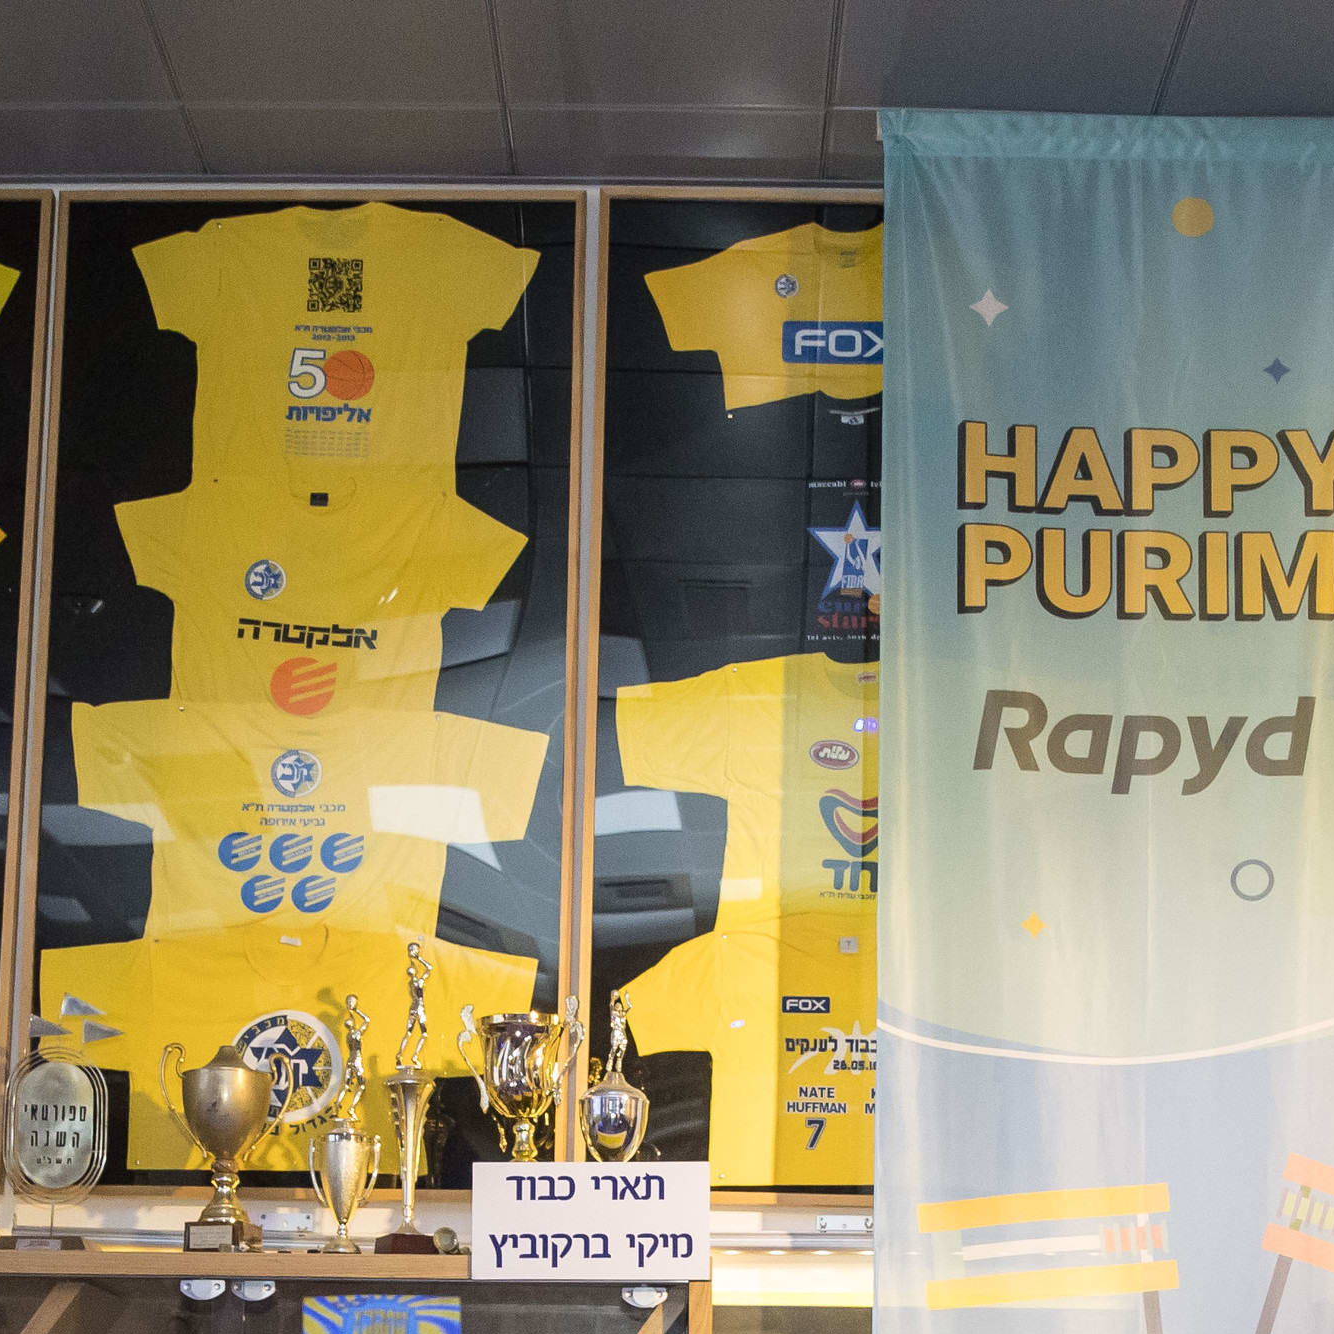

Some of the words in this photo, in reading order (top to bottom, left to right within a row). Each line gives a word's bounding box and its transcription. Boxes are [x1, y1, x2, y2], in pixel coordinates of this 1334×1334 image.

[237, 617, 378, 650] אלקטרה
[972, 689, 1317, 796] Rapyd
[267, 803, 315, 814] אלקטרה
[319, 803, 346, 812] מכבי
[260, 817, 297, 827] אירופה
[300, 818, 326, 827] גביעי
[786, 999, 826, 1011] FOX
[785, 1036, 838, 1055] לענקים
[798, 1086, 836, 1099] NATE
[23, 1103, 87, 1122] ספורטאי
[786, 1102, 847, 1114] HUFFMAN
[30, 1130, 80, 1148] השנה
[805, 1117, 827, 1151] 7
[506, 1175, 576, 1201] כבוד
[591, 1172, 665, 1201] תארי
[489, 1233, 612, 1268] ברקוביץ
[626, 1233, 693, 1268] מיקי
